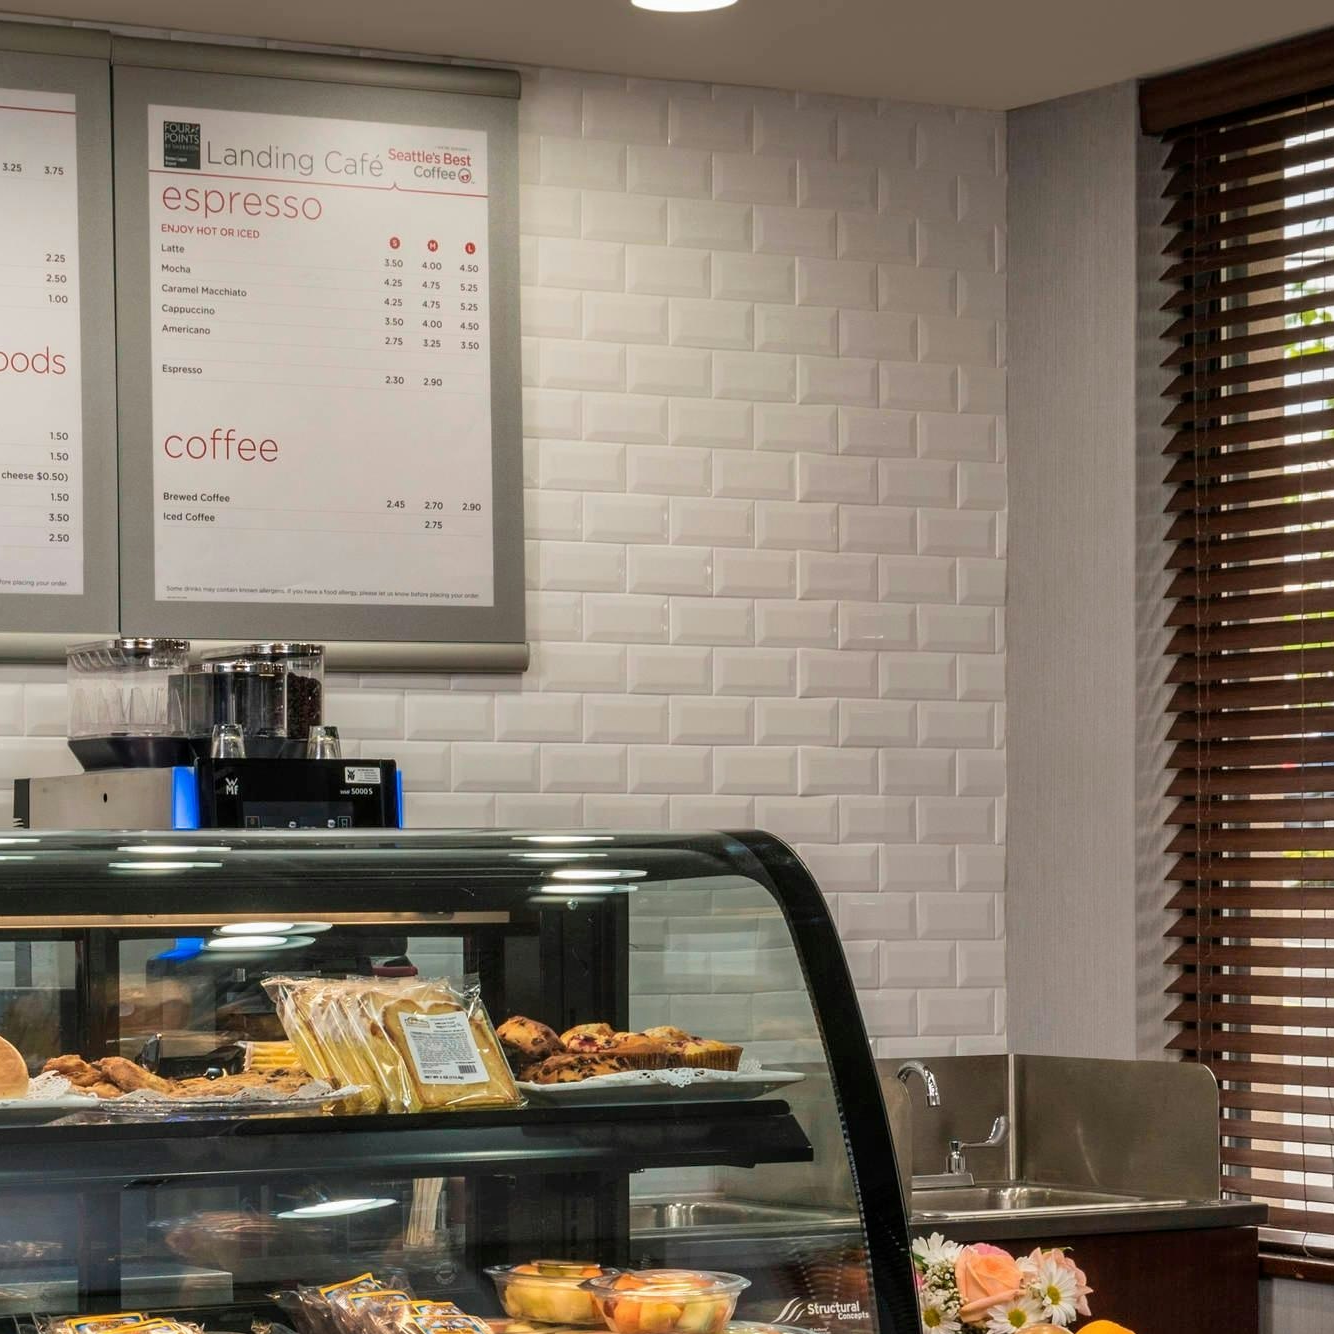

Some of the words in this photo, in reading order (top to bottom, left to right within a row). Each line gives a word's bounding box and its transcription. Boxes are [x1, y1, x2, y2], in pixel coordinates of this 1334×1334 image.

[165, 123, 190, 133] FOUR
[165, 133, 199, 144] POINTS
[207, 140, 313, 176] Landing
[325, 151, 383, 177] Café
[444, 153, 471, 166] Best
[2, 162, 23, 173] 3.25
[44, 165, 65, 176] 3.75
[414, 165, 456, 180] Coffee
[163, 186, 321, 220] espresso
[160, 223, 195, 234] ENJOY
[196, 226, 218, 237] HOT
[219, 227, 235, 237] OR
[236, 228, 260, 239] ICED
[161, 243, 185, 254] Latte
[45, 253, 66, 264] 2.25
[161, 263, 191, 274] Mocha
[384, 257, 404, 269] 3.50
[421, 261, 443, 271] 4.00
[459, 263, 479, 273] 4.50
[45, 273, 68, 284] 2.50
[161, 283, 199, 295] Caramel
[201, 285, 248, 298] Macchiato
[383, 278, 403, 288] 4.25
[421, 280, 441, 291] 4.75
[459, 282, 479, 293] 5.25
[48, 293, 69, 304] 1.00
[383, 297, 403, 307] 4.25
[421, 300, 441, 310] 4.75
[460, 302, 479, 312] 5.25
[161, 303, 216, 316] Cappuccino
[161, 323, 211, 335] Americano
[384, 316, 404, 327] 3.50
[421, 319, 443, 329] 4.00
[459, 321, 480, 331] 4.50
[384, 336, 404, 346] 2.75
[422, 338, 442, 348] 3.25
[460, 340, 480, 351] 3.50
[161, 363, 203, 375] Espresso
[385, 375, 405, 385] 2.30
[423, 377, 443, 387] 2.90
[49, 431, 69, 441] 1.50
[165, 428, 278, 462] coffee
[50, 451, 69, 462] 1.50
[1, 470, 34, 481] cheese
[36, 471, 69, 483] $0.50)
[50, 492, 70, 502] 1.50
[162, 491, 198, 502] Brewed
[200, 493, 231, 503] Coffee
[386, 499, 406, 509] 2.45
[424, 501, 444, 511] 2.70
[462, 502, 482, 512] 2.90
[48, 512, 70, 523] 3.50
[163, 511, 183, 521] Iced
[185, 512, 216, 522] Coffee
[424, 520, 443, 530] 2.75
[48, 533, 70, 543] 2.50
[807, 1301, 860, 1314] Structural
[838, 1312, 869, 1320] Concepts
